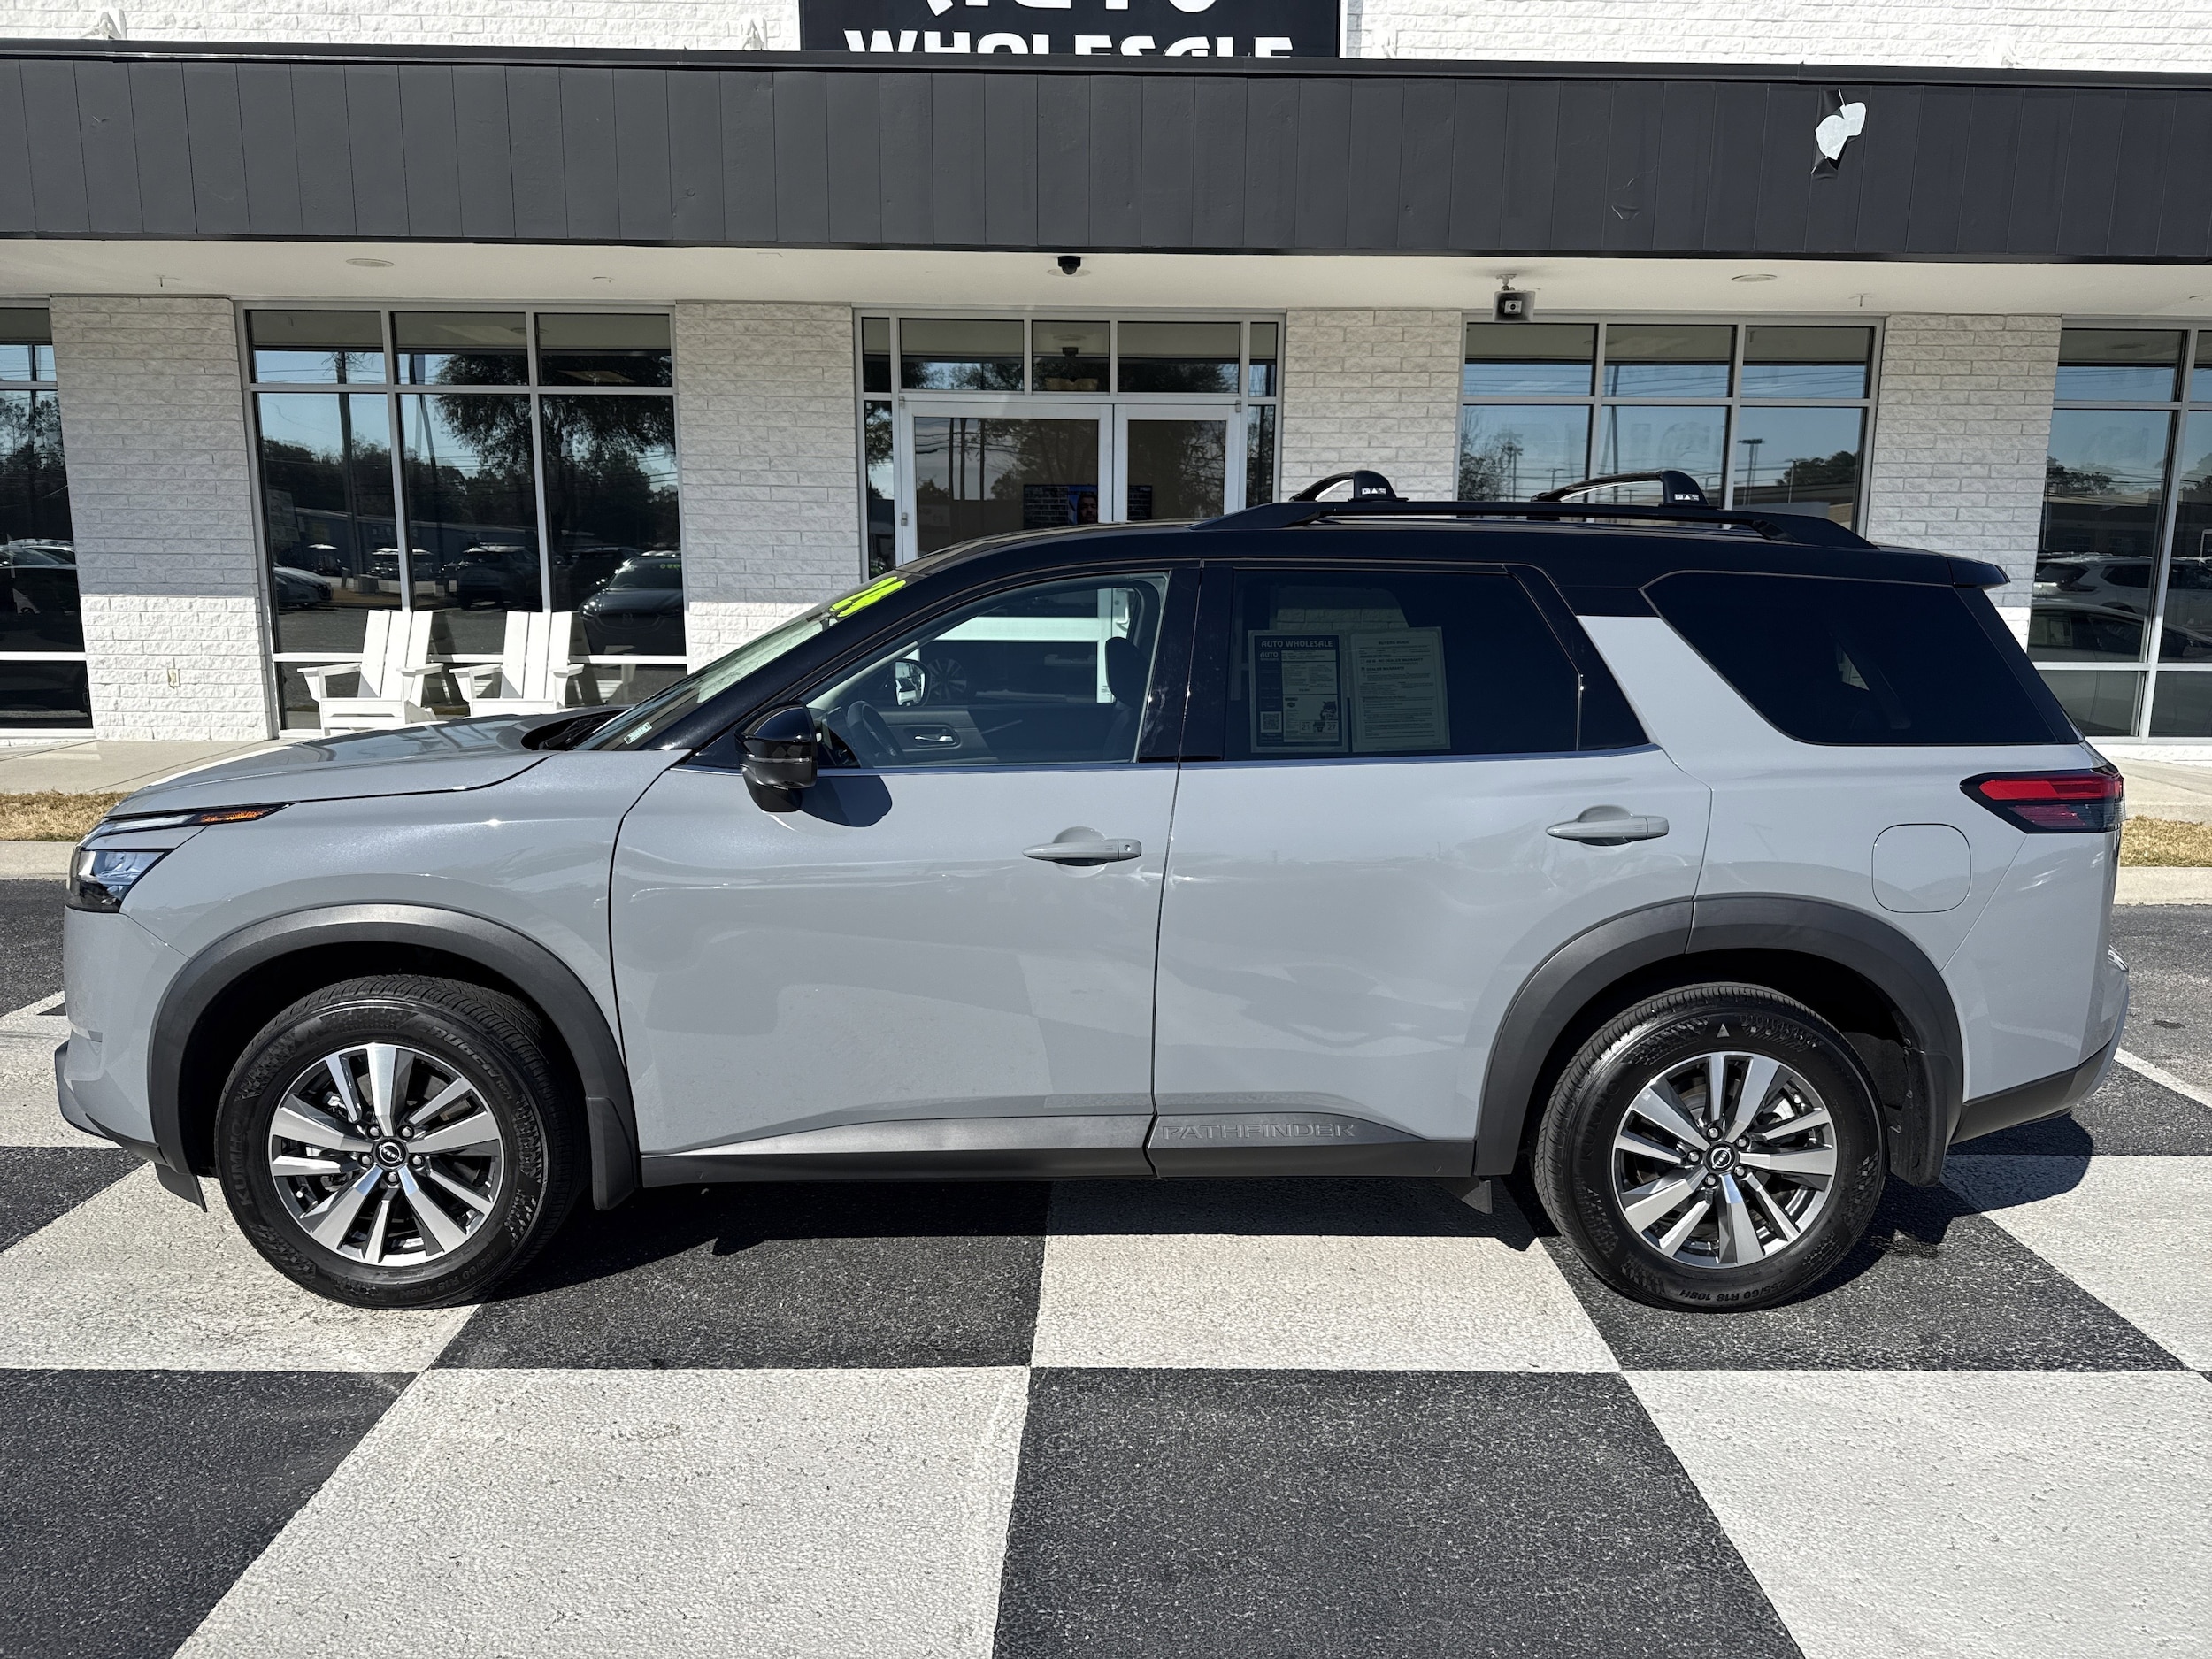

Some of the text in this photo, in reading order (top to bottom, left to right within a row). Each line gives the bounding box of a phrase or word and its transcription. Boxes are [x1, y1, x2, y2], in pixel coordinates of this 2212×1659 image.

[1261, 640, 1283, 649] AUTO
[1162, 1123, 1356, 1140] PATHFINDER
[229, 1118, 254, 1206] KUMHO
[1678, 1279, 1786, 1302] 255/60 R18 108H
